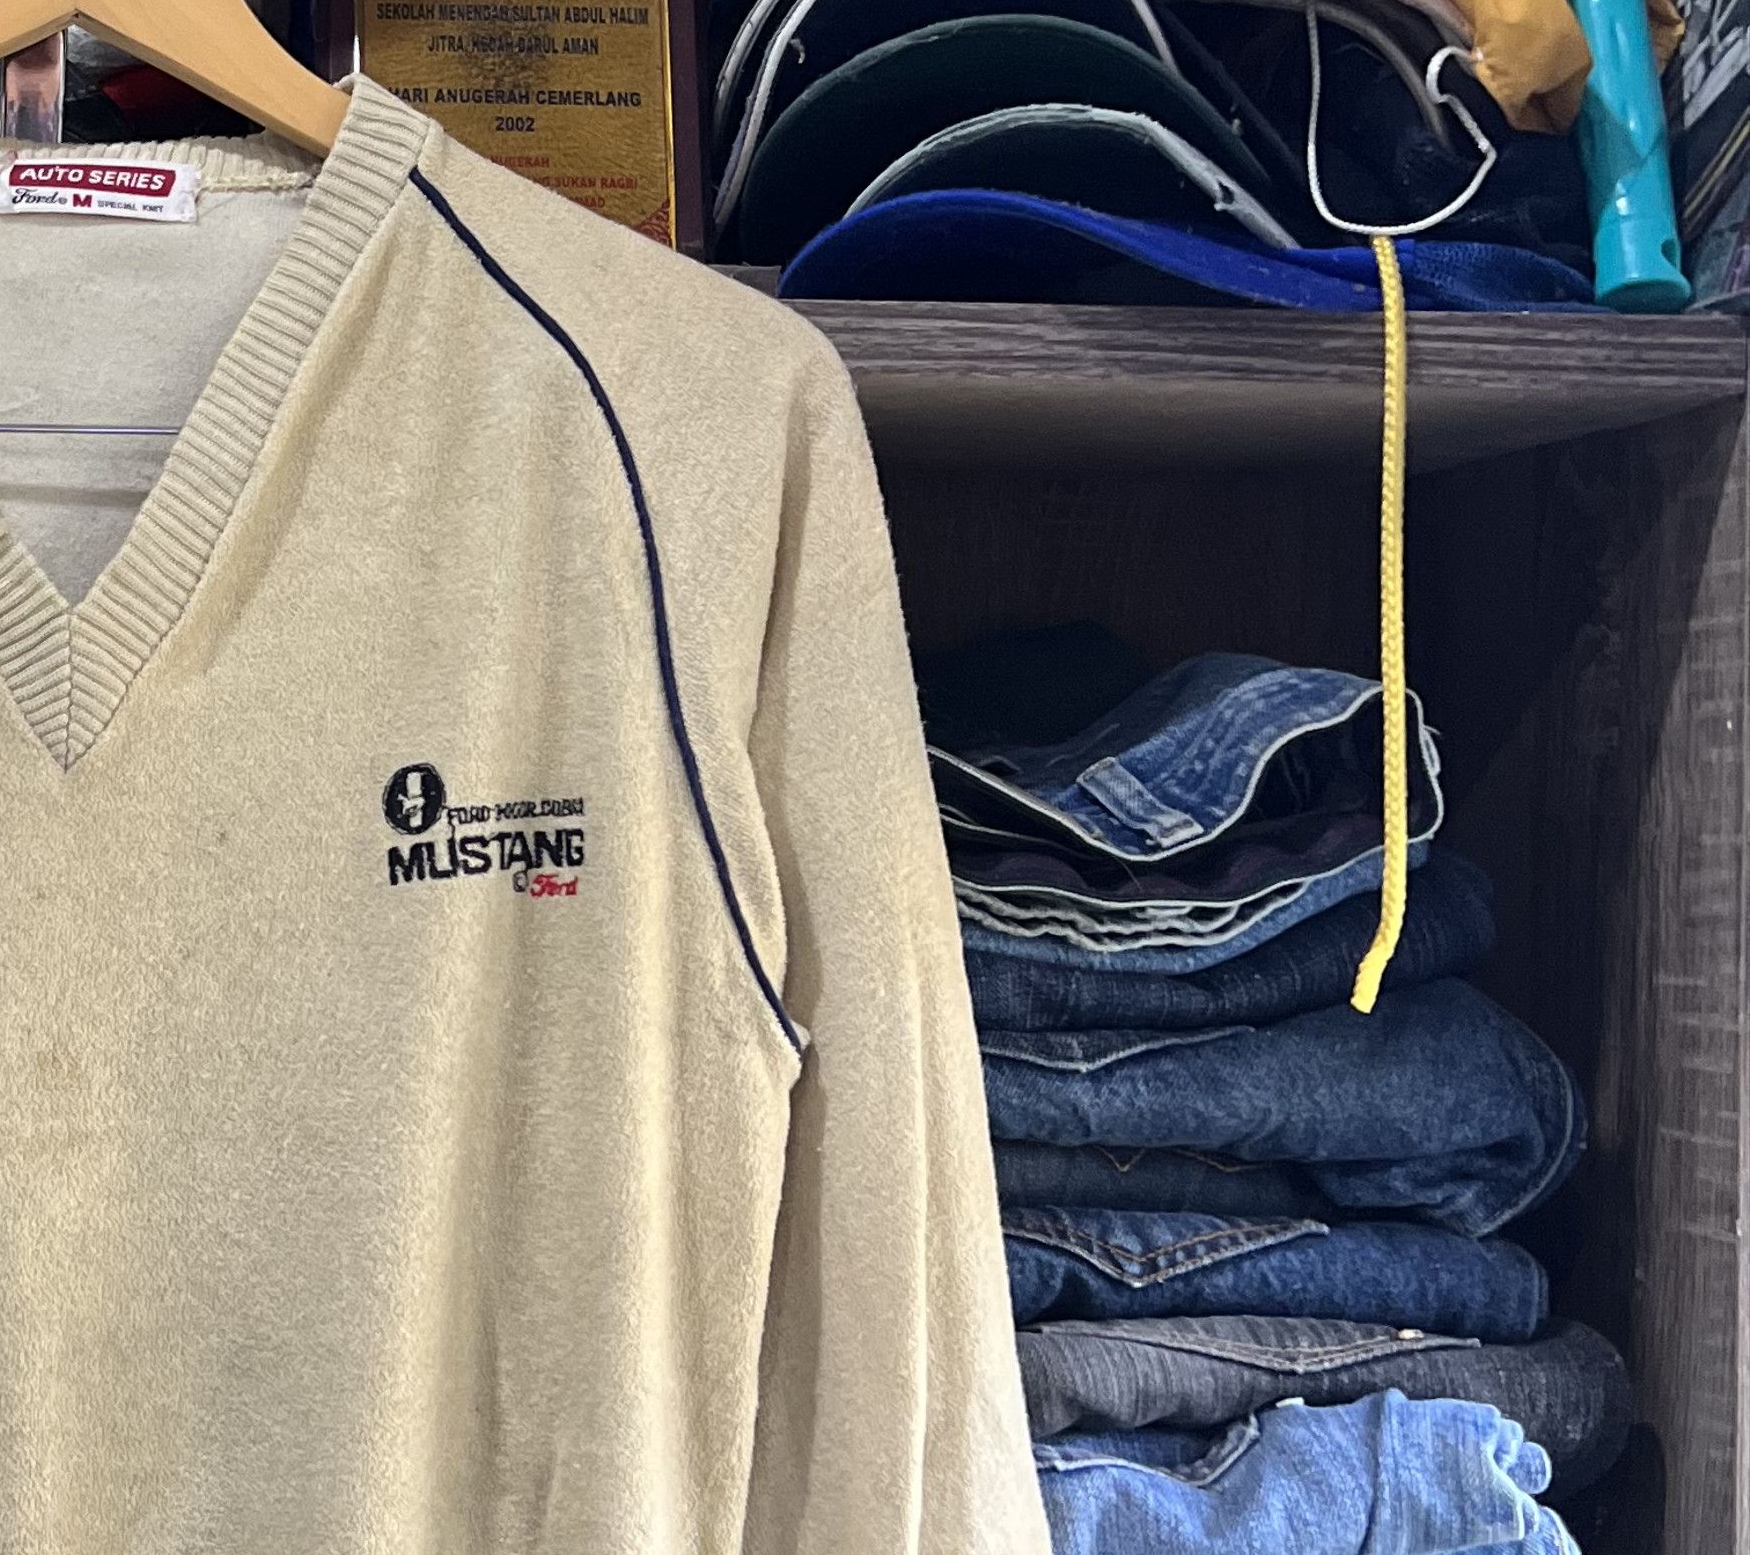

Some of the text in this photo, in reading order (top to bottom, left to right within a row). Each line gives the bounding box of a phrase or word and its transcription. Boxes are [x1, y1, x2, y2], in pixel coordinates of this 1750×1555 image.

[377, 3, 435, 20] SEKOLAH
[513, 5, 561, 23] SULTAN
[564, 6, 606, 24] ABDUL
[610, 7, 649, 25] HALIM
[518, 36, 559, 55] DARUL
[562, 37, 599, 55] AMAN
[434, 87, 530, 105] ANUGERAH
[535, 90, 642, 107] CEMERLANG
[495, 116, 536, 132] 2002
[19, 165, 167, 191] AUTO SERIES
[553, 176, 597, 188] SUKAN
[72, 194, 92, 208] M
[387, 828, 585, 886] MUSTANG
